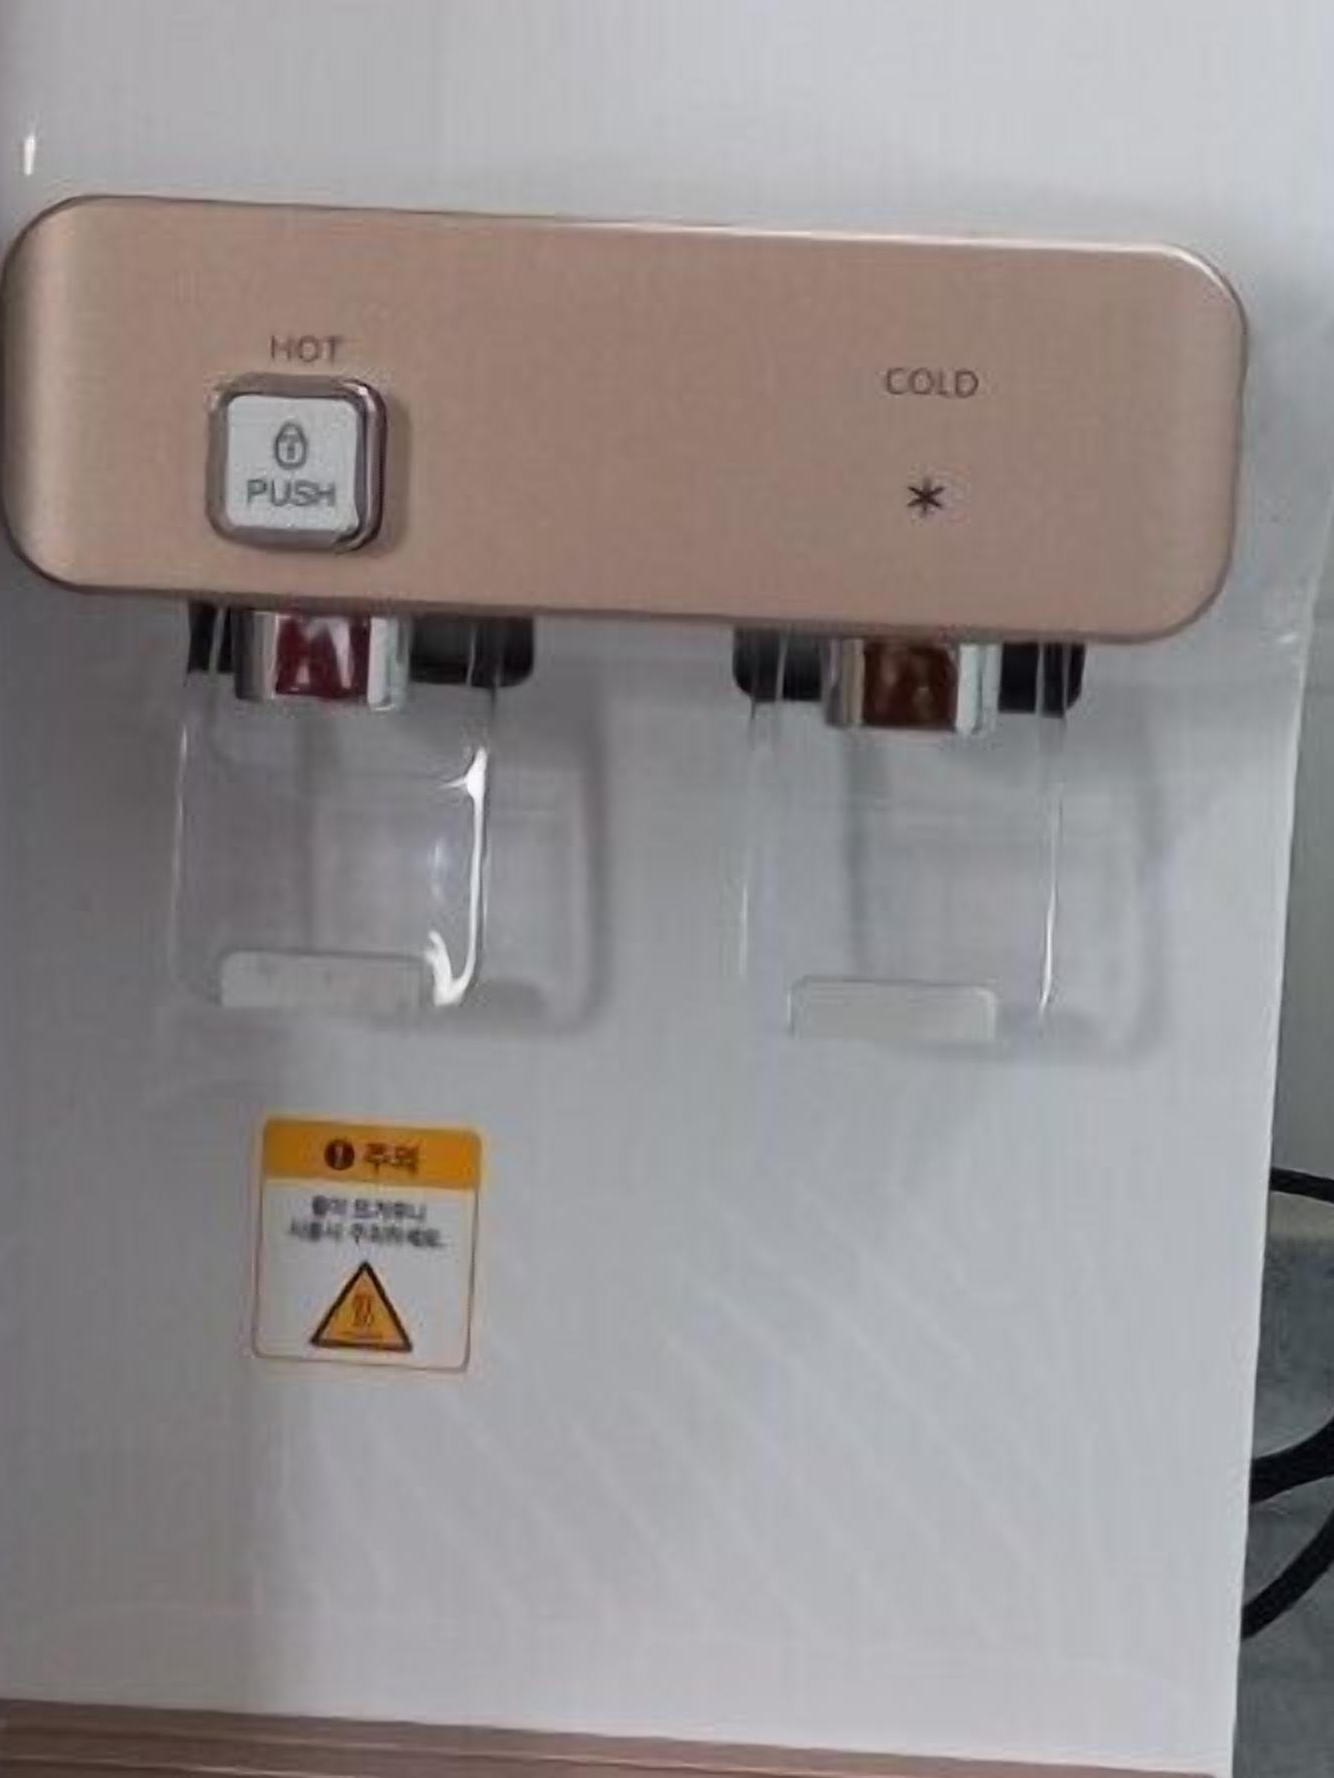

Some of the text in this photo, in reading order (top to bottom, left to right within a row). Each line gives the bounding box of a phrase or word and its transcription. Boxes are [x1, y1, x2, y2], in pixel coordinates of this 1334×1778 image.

[269, 334, 343, 365] HOT
[885, 366, 980, 400] COLD
[245, 478, 337, 508] PUSH
